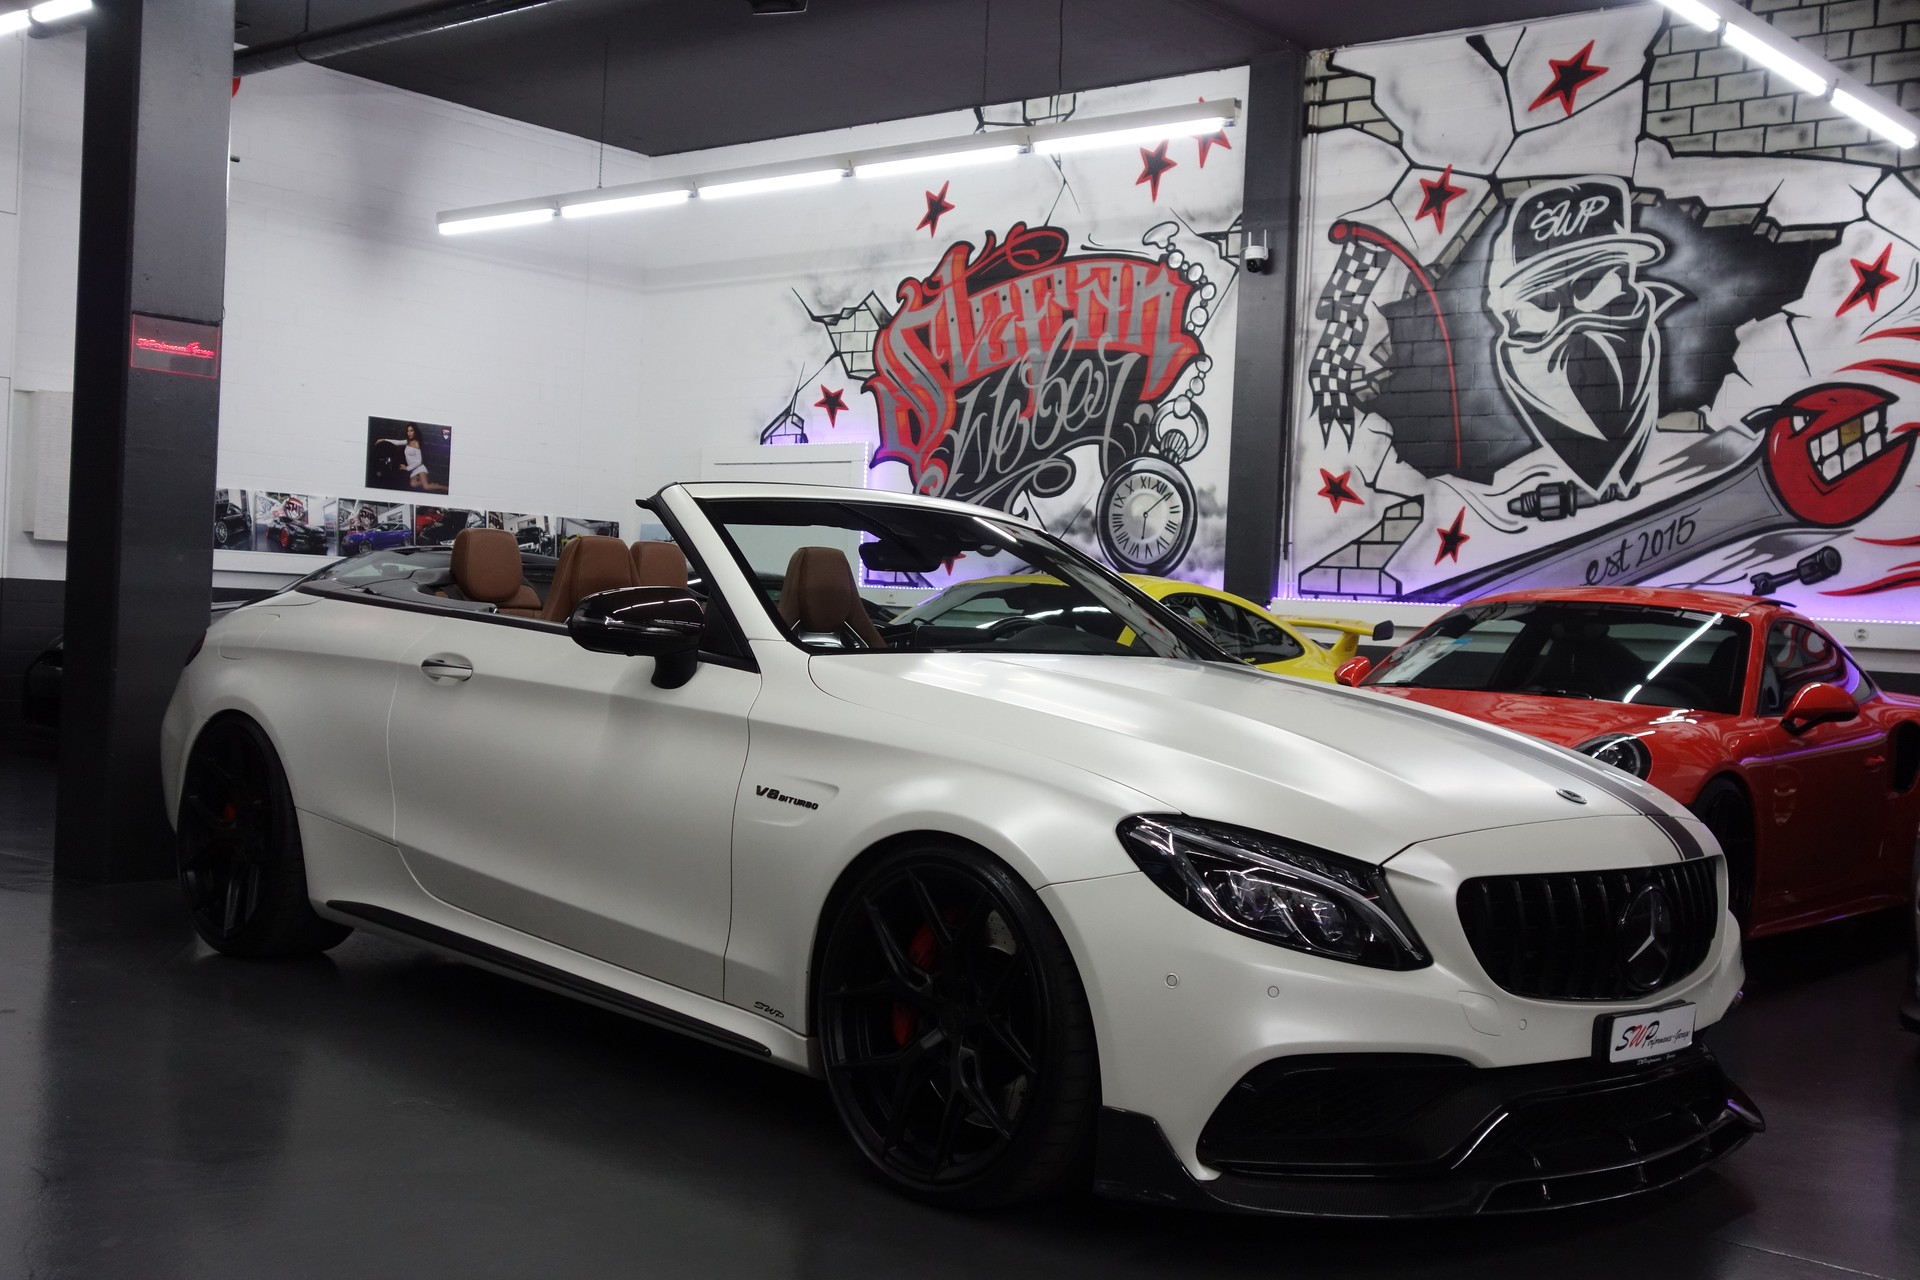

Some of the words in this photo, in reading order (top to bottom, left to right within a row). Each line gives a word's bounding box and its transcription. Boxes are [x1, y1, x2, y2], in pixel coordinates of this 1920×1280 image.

[1530, 196, 1610, 241] SWP
[943, 318, 1141, 485] Weber
[1579, 538, 1634, 586] est
[1636, 507, 1702, 568] 2015
[756, 784, 780, 800] V8
[778, 794, 819, 810] BITURBO
[753, 1001, 785, 1018] SWP
